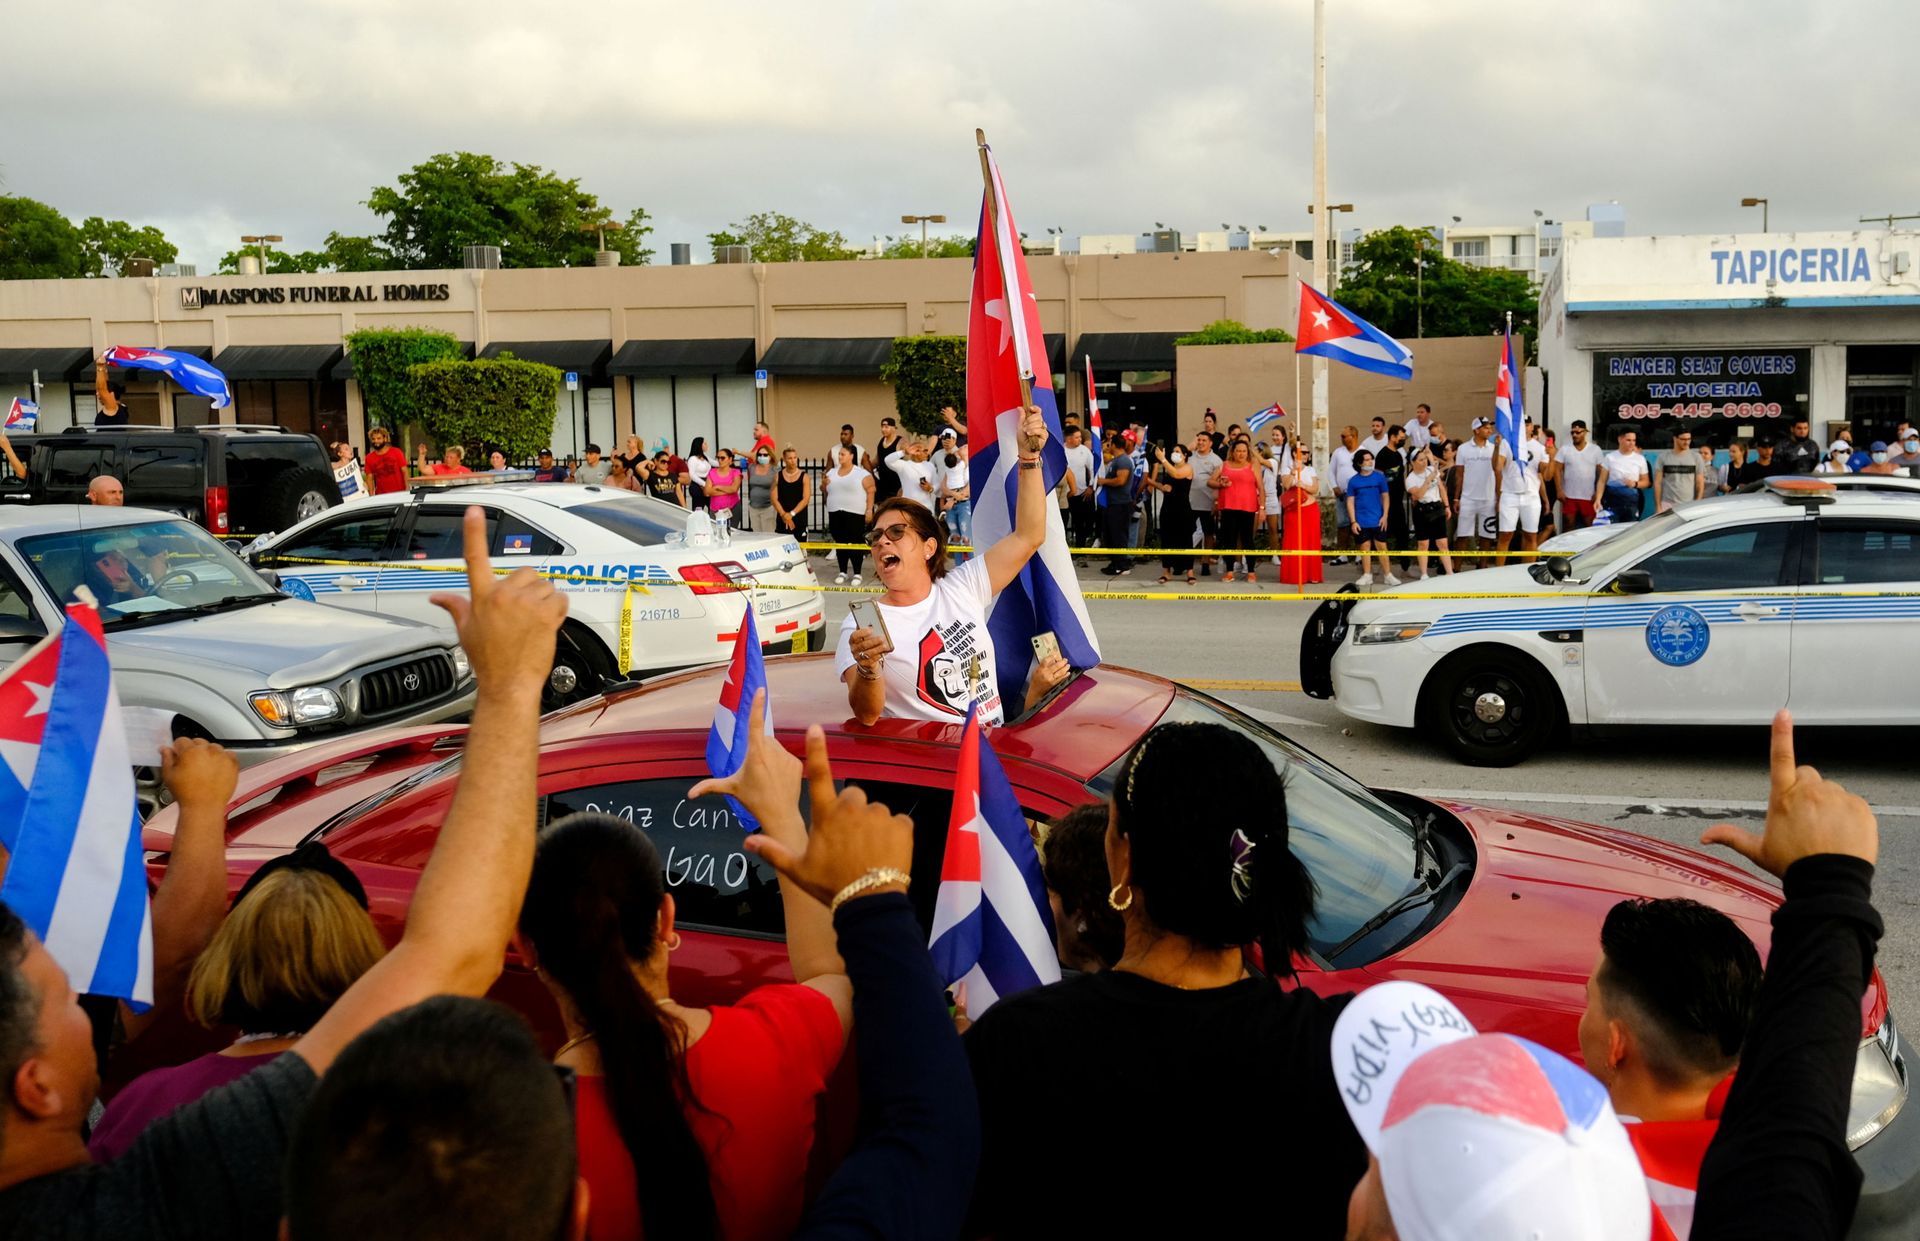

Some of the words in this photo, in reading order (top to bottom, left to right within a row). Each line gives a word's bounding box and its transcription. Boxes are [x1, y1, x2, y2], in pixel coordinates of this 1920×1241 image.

[1710, 247, 1871, 285] TAPICERIA
[201, 287, 285, 306] MASPONS
[289, 285, 377, 303] FUNERAL
[383, 284, 450, 301] HOMES
[1609, 356, 1676, 376] RANGER
[1681, 356, 1723, 375] SEAT
[1728, 355, 1796, 375] COVERS
[1647, 382, 1762, 398] TAPICERIA
[1618, 402, 1782, 419] 305-445-6699
[337, 461, 358, 479] CUBA
[745, 549, 770, 562] MIAMI
[549, 564, 646, 586] POLICE
[640, 609, 680, 621] 216718
[760, 599, 781, 613] 216718
[941, 619, 962, 640] AIROBI
[960, 650, 987, 670] HELNKI
